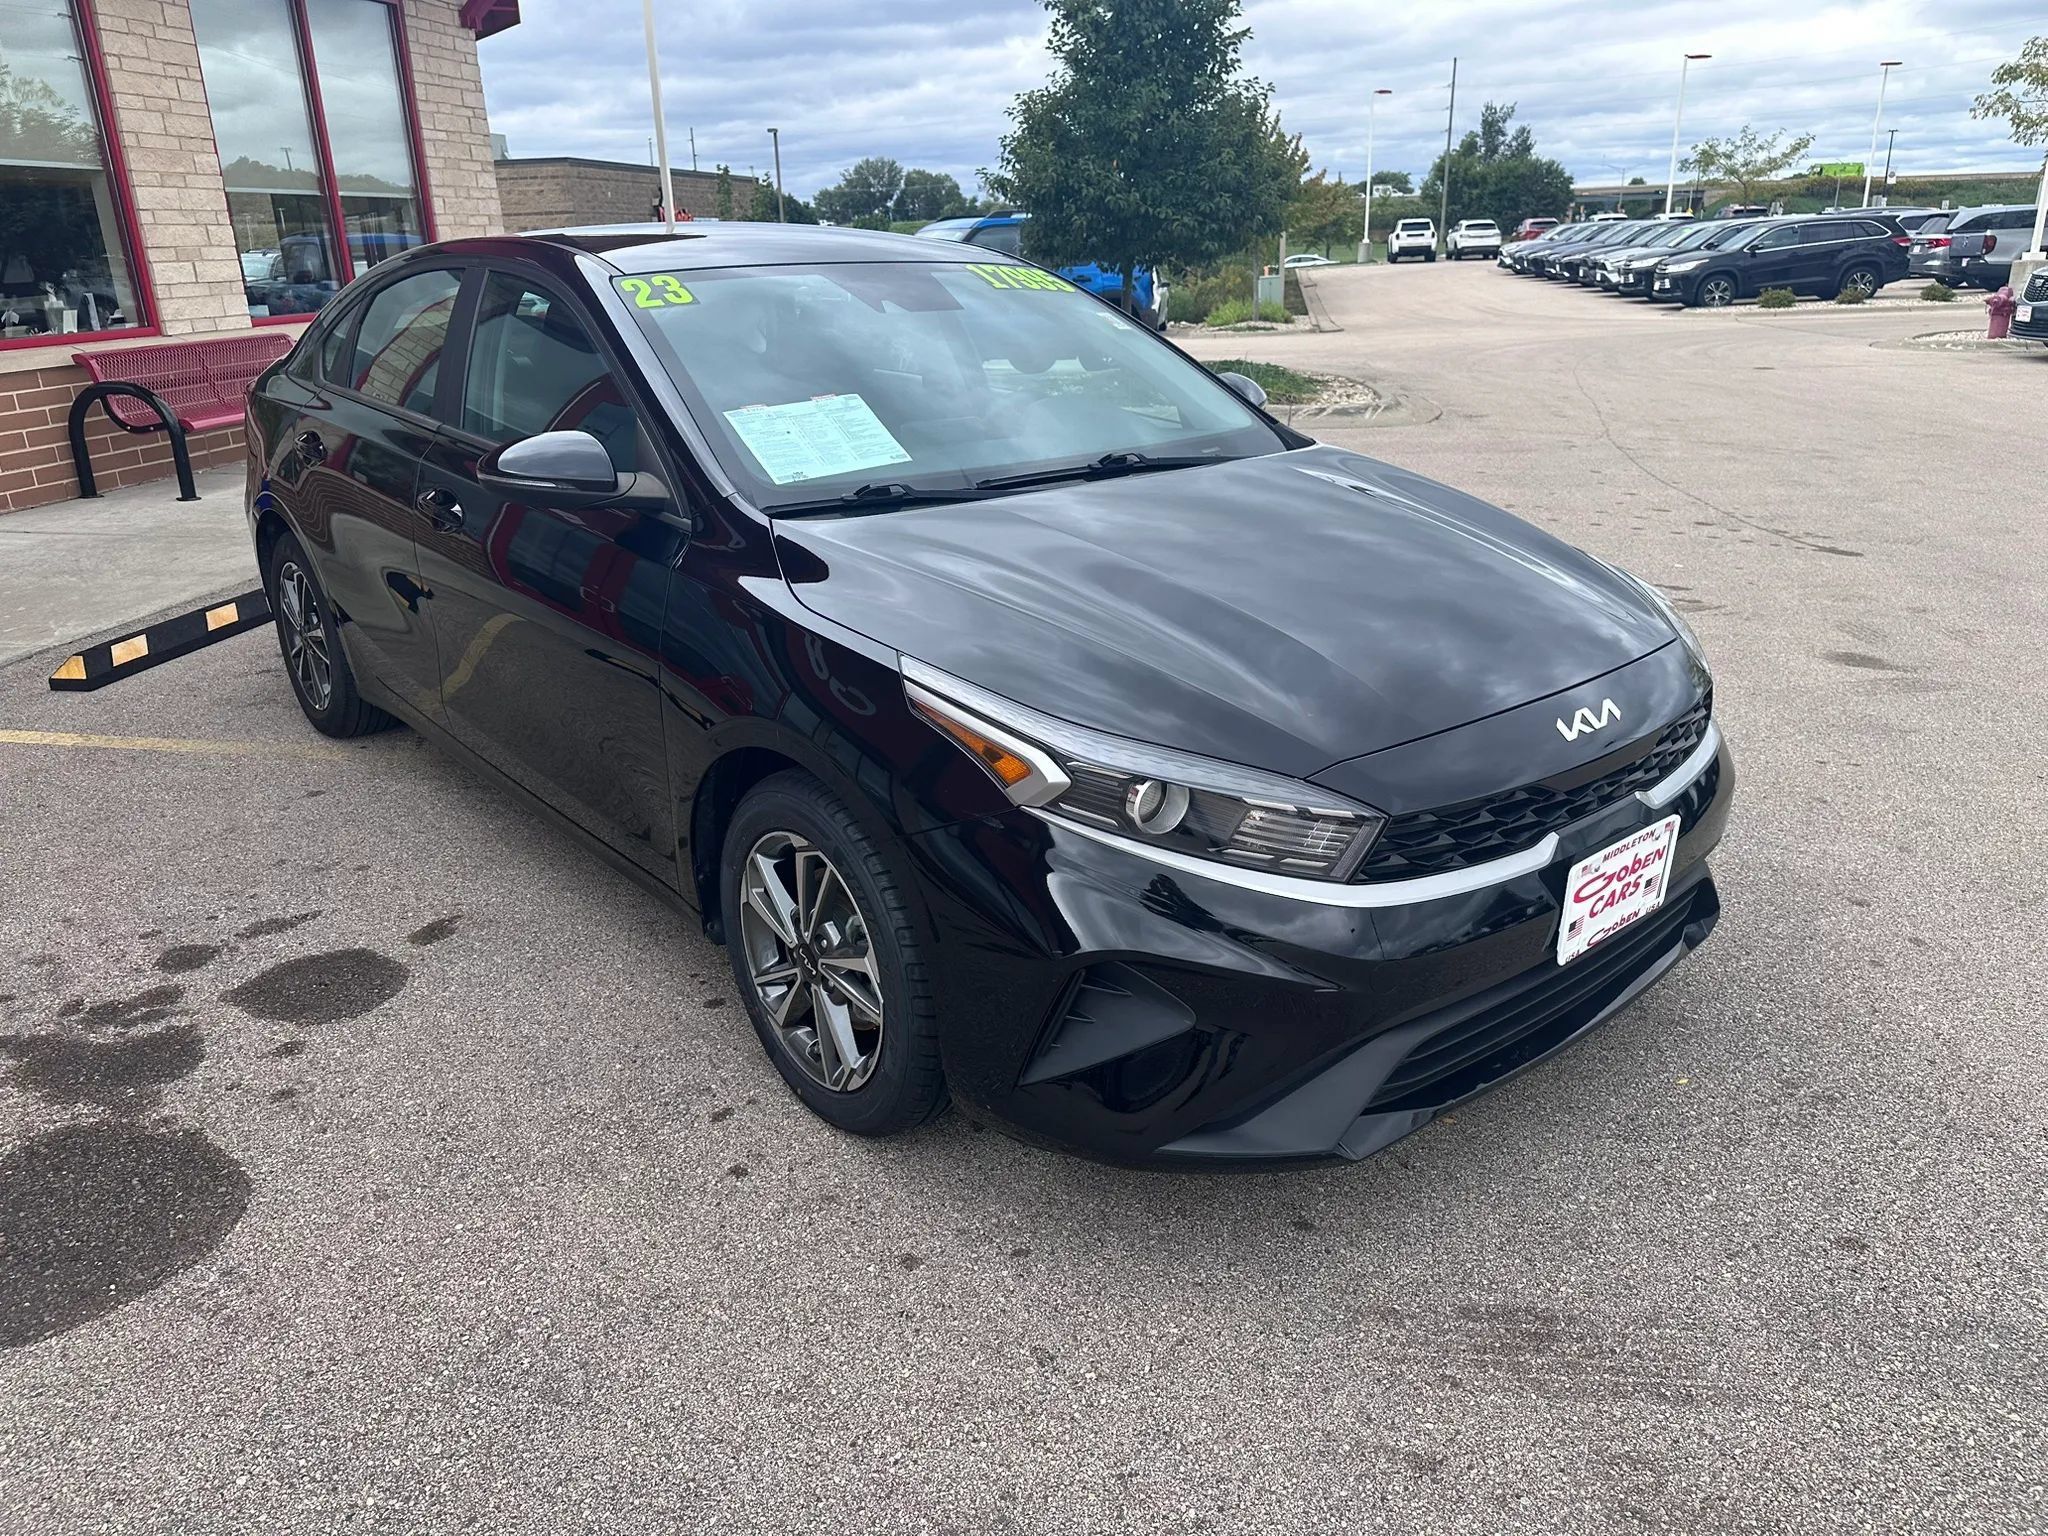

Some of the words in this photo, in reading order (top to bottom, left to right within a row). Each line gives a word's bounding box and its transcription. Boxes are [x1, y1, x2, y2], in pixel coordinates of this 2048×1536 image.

[620, 275, 694, 309] 23
[965, 263, 1077, 293] 17995
[1556, 698, 1621, 742] KIA
[1602, 829, 1657, 864] MIDDLETON
[1589, 874, 1643, 918] CARS
